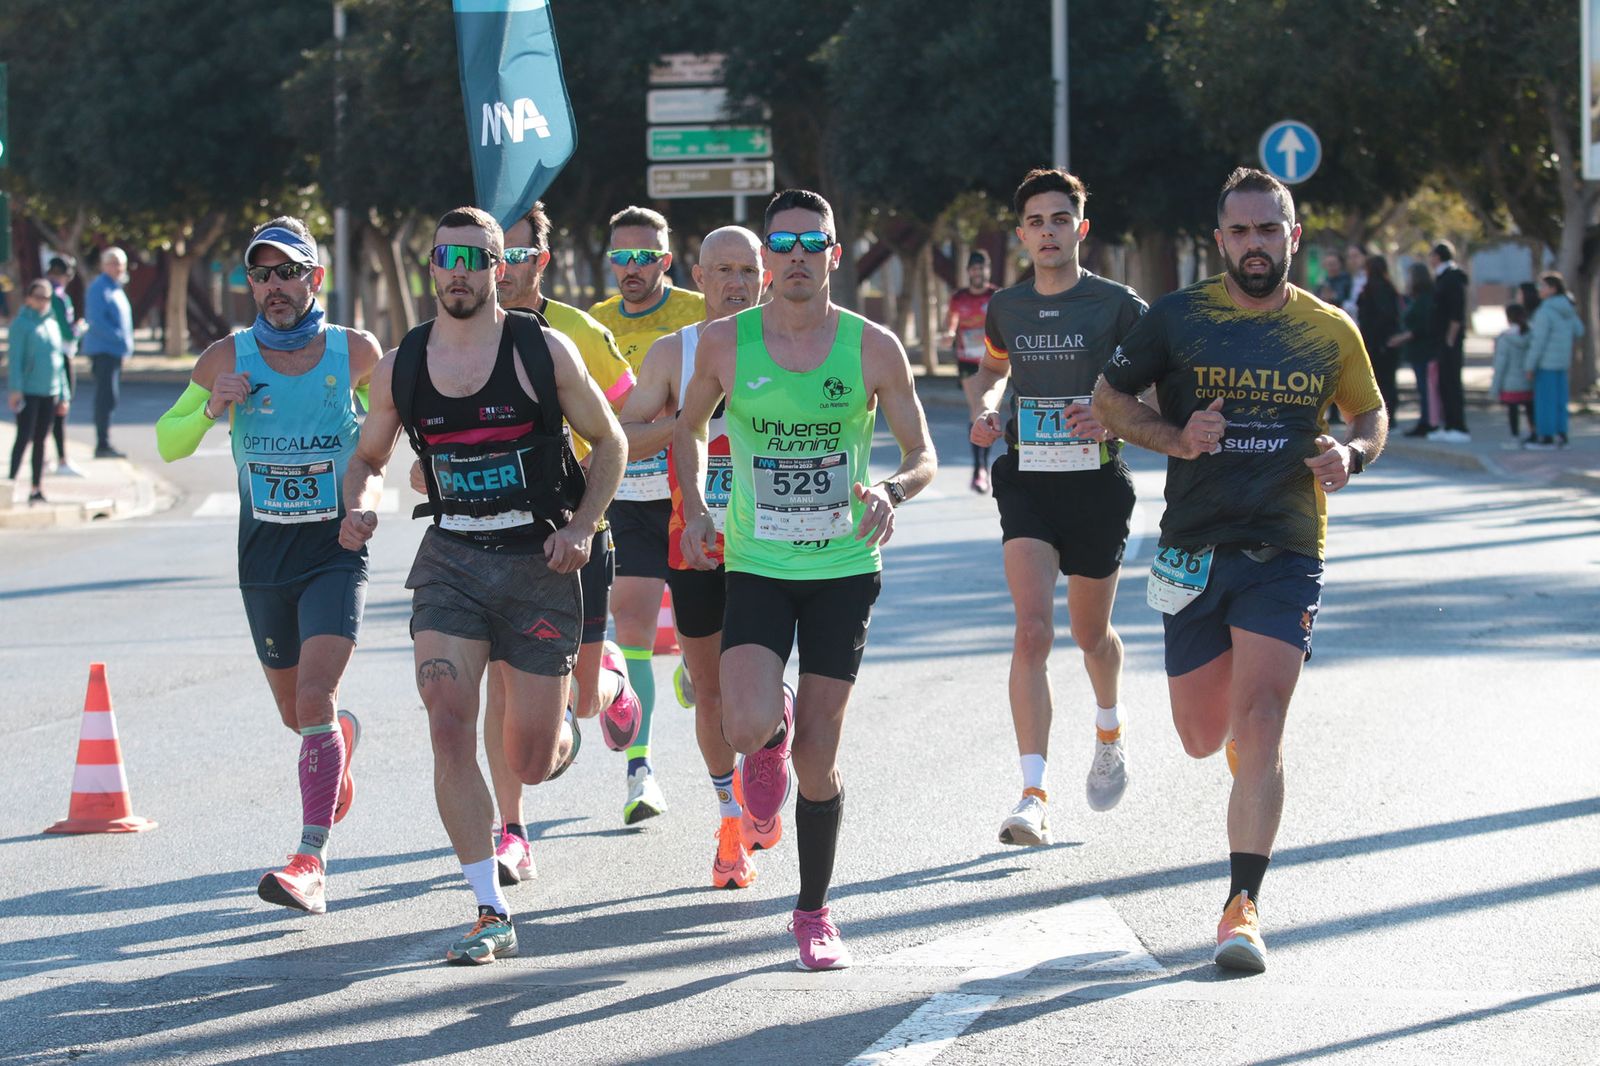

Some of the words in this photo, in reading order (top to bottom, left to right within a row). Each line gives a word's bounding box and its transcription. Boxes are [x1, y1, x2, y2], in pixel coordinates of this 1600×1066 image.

[1015, 334, 1085, 349] CUELLAR
[1193, 366, 1325, 394] TRIATLON
[1195, 388, 1247, 400] CIUDAD
[1250, 391, 1270, 401] DE
[752, 416, 841, 437] Universo
[1034, 411, 1068, 431] 71
[767, 437, 840, 453] Running
[1225, 436, 1289, 453] sulayr
[265, 477, 319, 500] 763
[437, 465, 519, 492] PACER
[706, 469, 733, 492] 78
[773, 470, 831, 496] 529
[284, 500, 311, 508] MARFIL
[1158, 546, 1204, 575] 236
[308, 748, 319, 774] RUN
